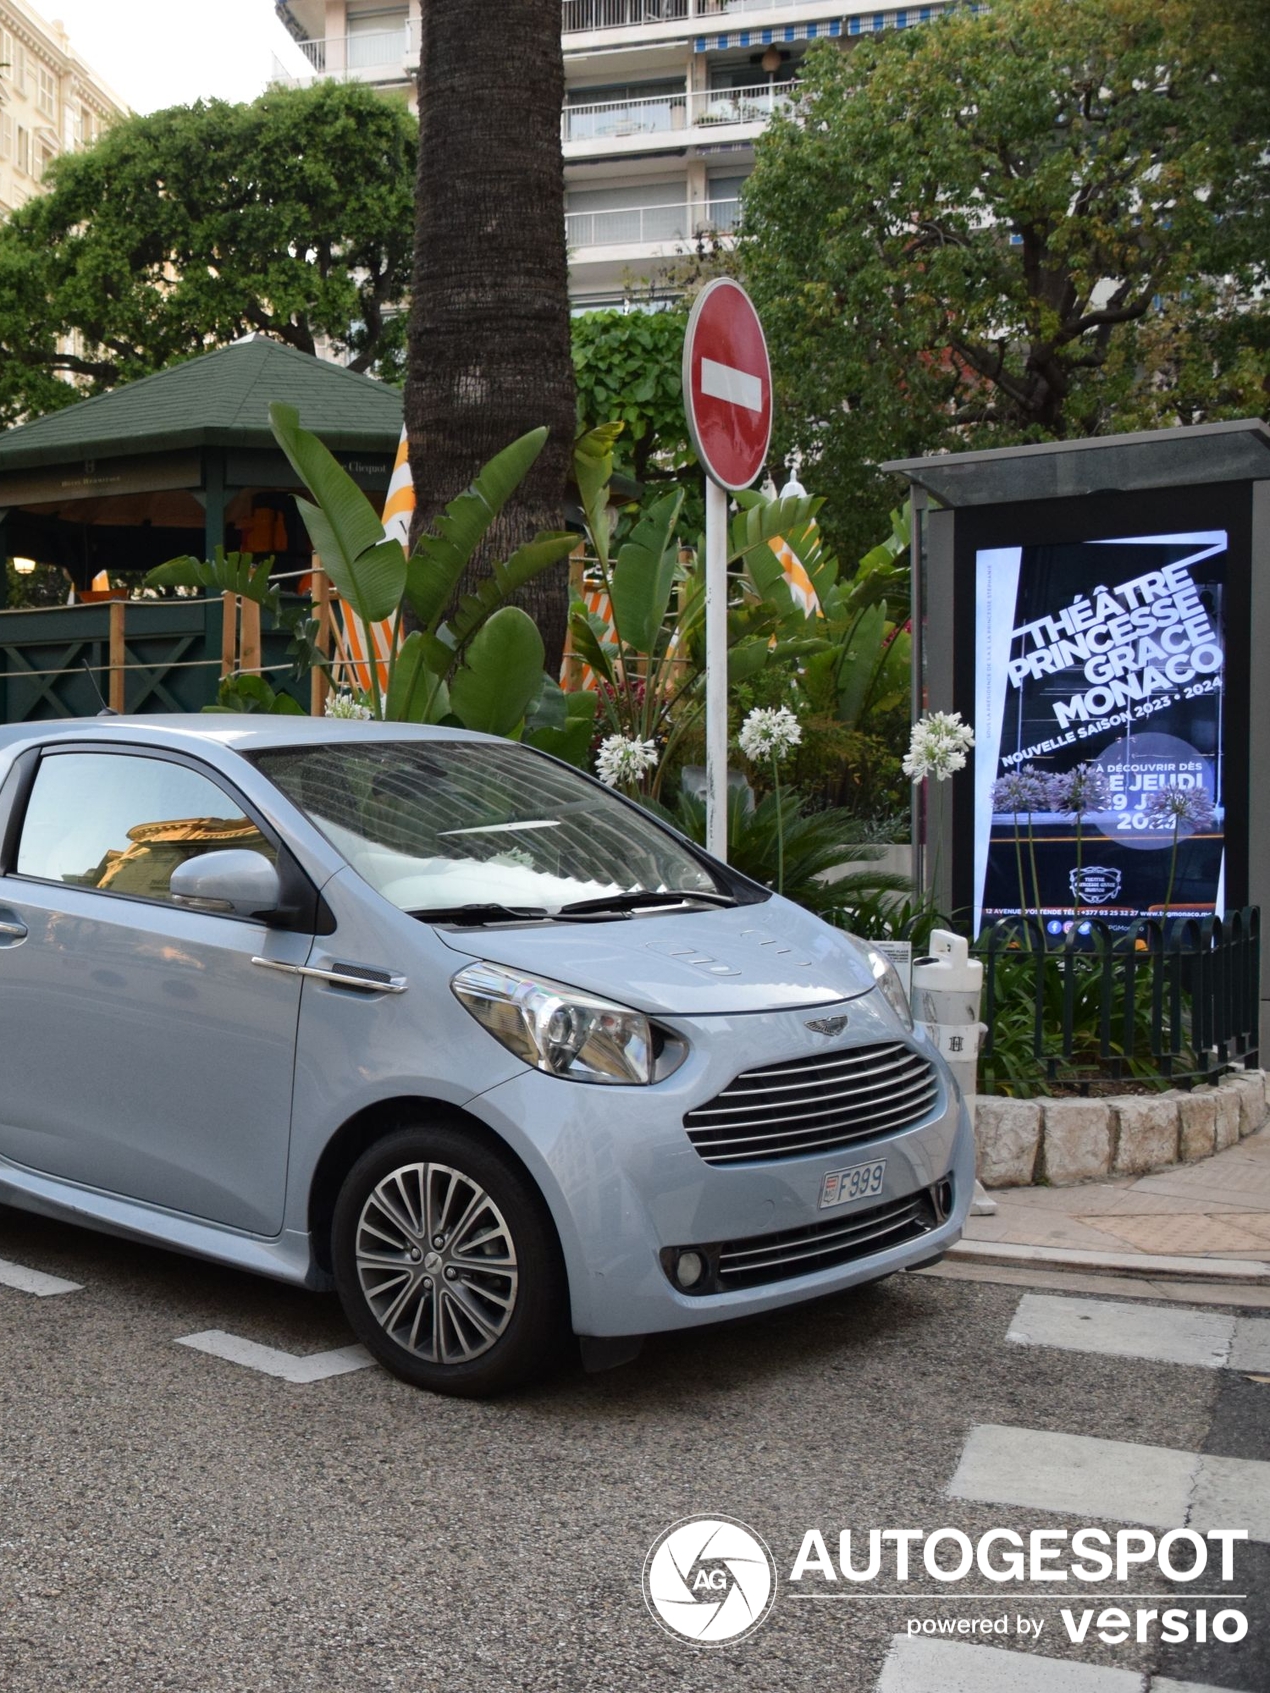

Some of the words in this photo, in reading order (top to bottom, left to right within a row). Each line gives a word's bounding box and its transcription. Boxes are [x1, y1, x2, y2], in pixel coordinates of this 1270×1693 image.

[348, 461, 387, 475] Clicquot
[1027, 566, 1196, 649] THÉÂTRE
[1006, 585, 1206, 689] PRINCESSE
[1083, 612, 1217, 685] GRACE
[1052, 643, 1224, 730] MONACO
[1001, 731, 1077, 768] NOUVELLE
[1076, 709, 1132, 739] SAISON
[1133, 695, 1172, 718] 2023
[1182, 676, 1223, 700] 2024
[1095, 763, 1105, 773] À
[1107, 762, 1176, 773] DÉCOUVRIR
[1179, 760, 1203, 771] DÈS
[1129, 773, 1203, 791] JEUDI
[1140, 910, 1212, 918] www.tgmonaco.m
[838, 1165, 883, 1201] F999
